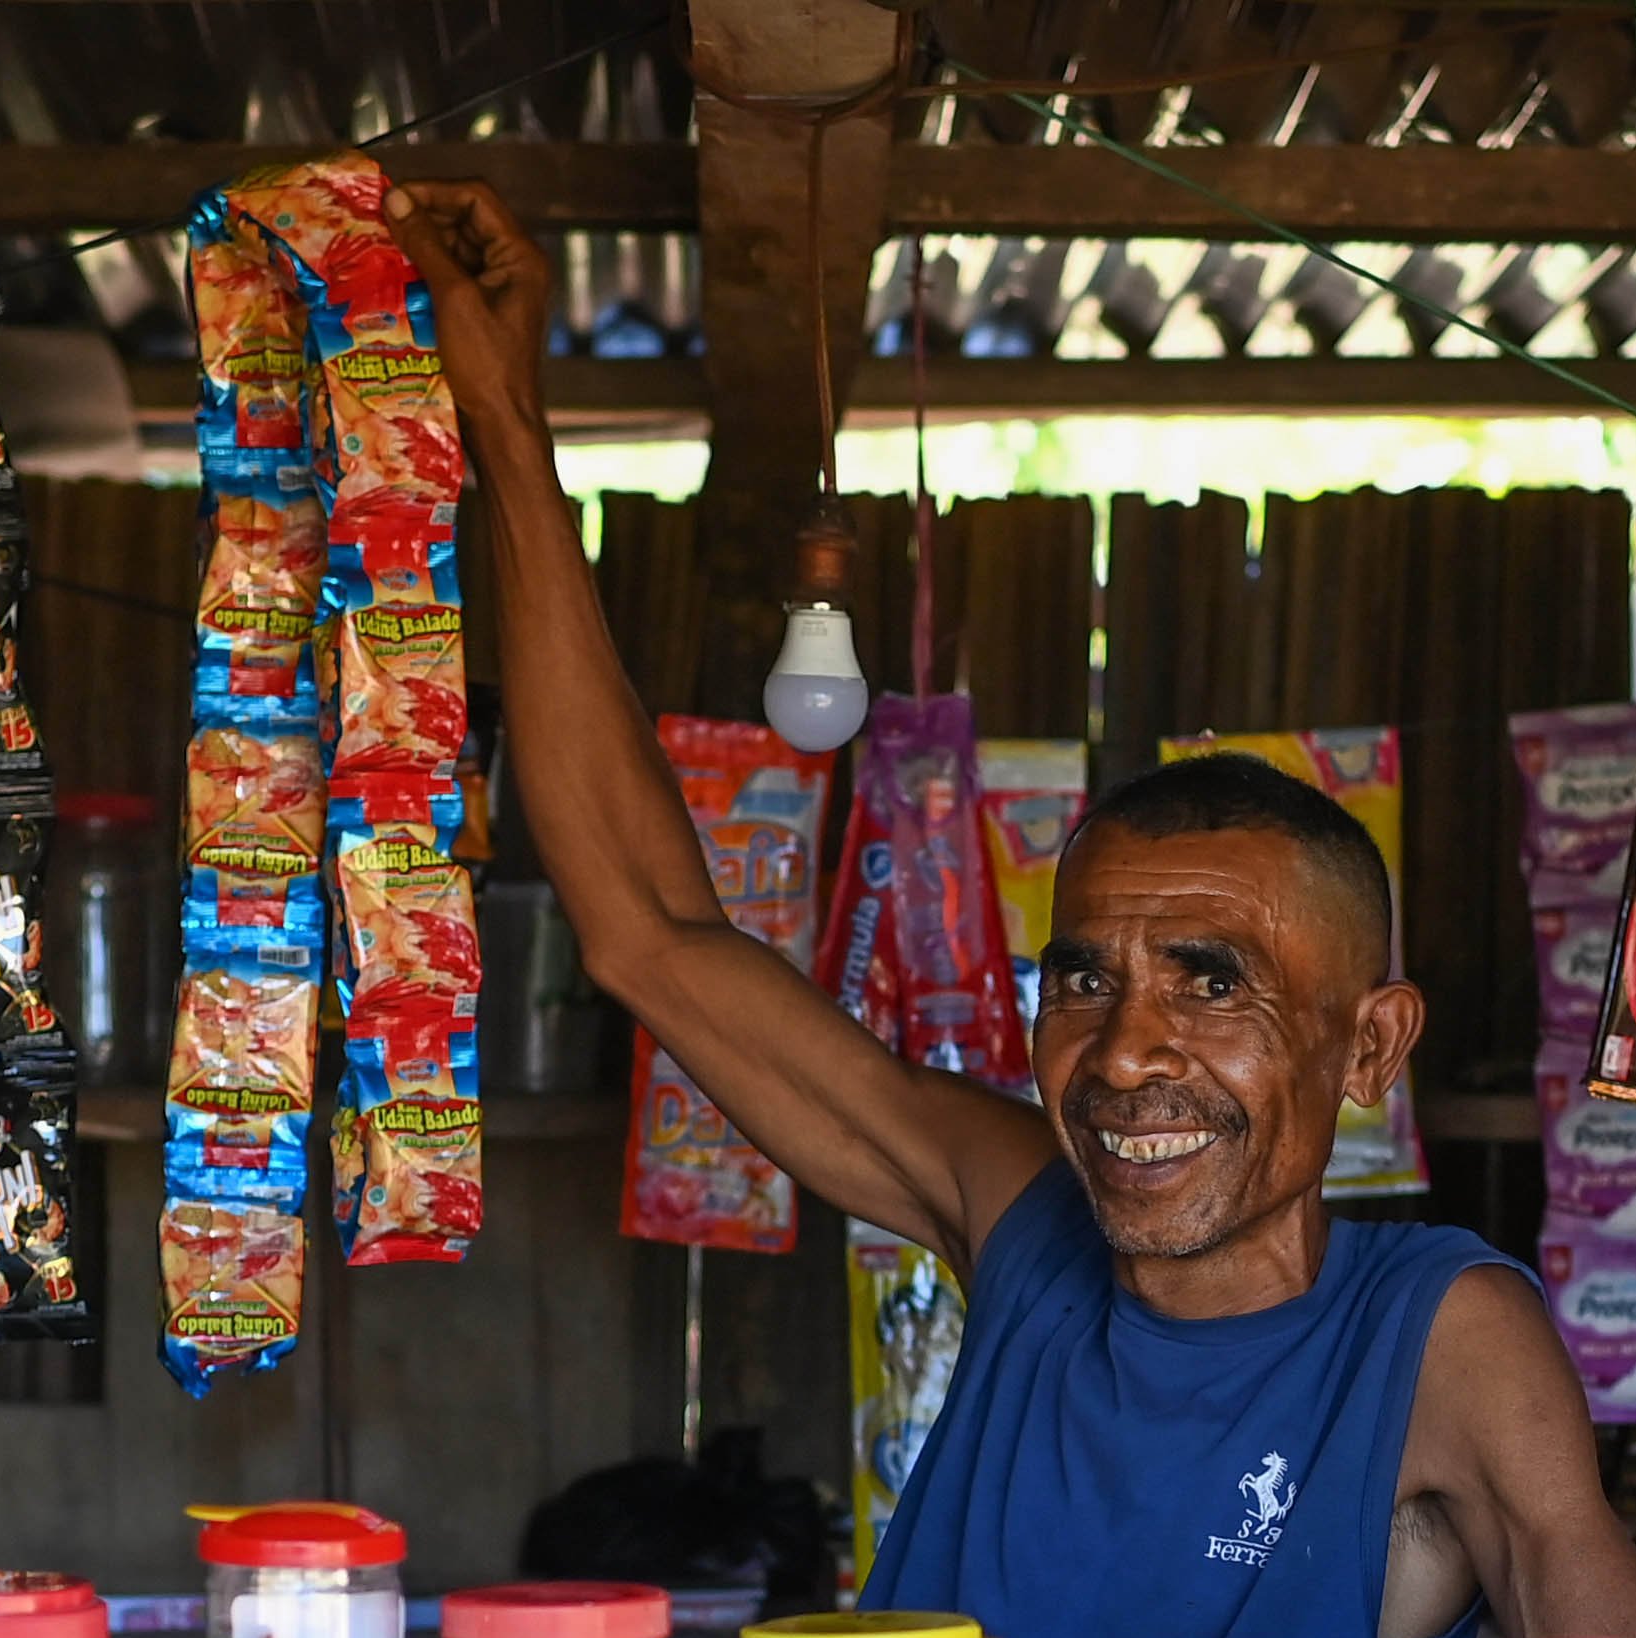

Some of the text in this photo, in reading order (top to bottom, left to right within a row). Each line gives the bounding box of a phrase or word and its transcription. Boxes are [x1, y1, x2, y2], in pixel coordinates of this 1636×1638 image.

[337, 352, 442, 384] Udang Balado
[355, 610, 461, 642] Udang Balado
[0, 719, 33, 751] 15
[354, 847, 410, 876] Udang
[713, 828, 806, 900] aia
[373, 1104, 481, 1134] Udang Balado
[177, 1314, 285, 1339] Udang Balado
